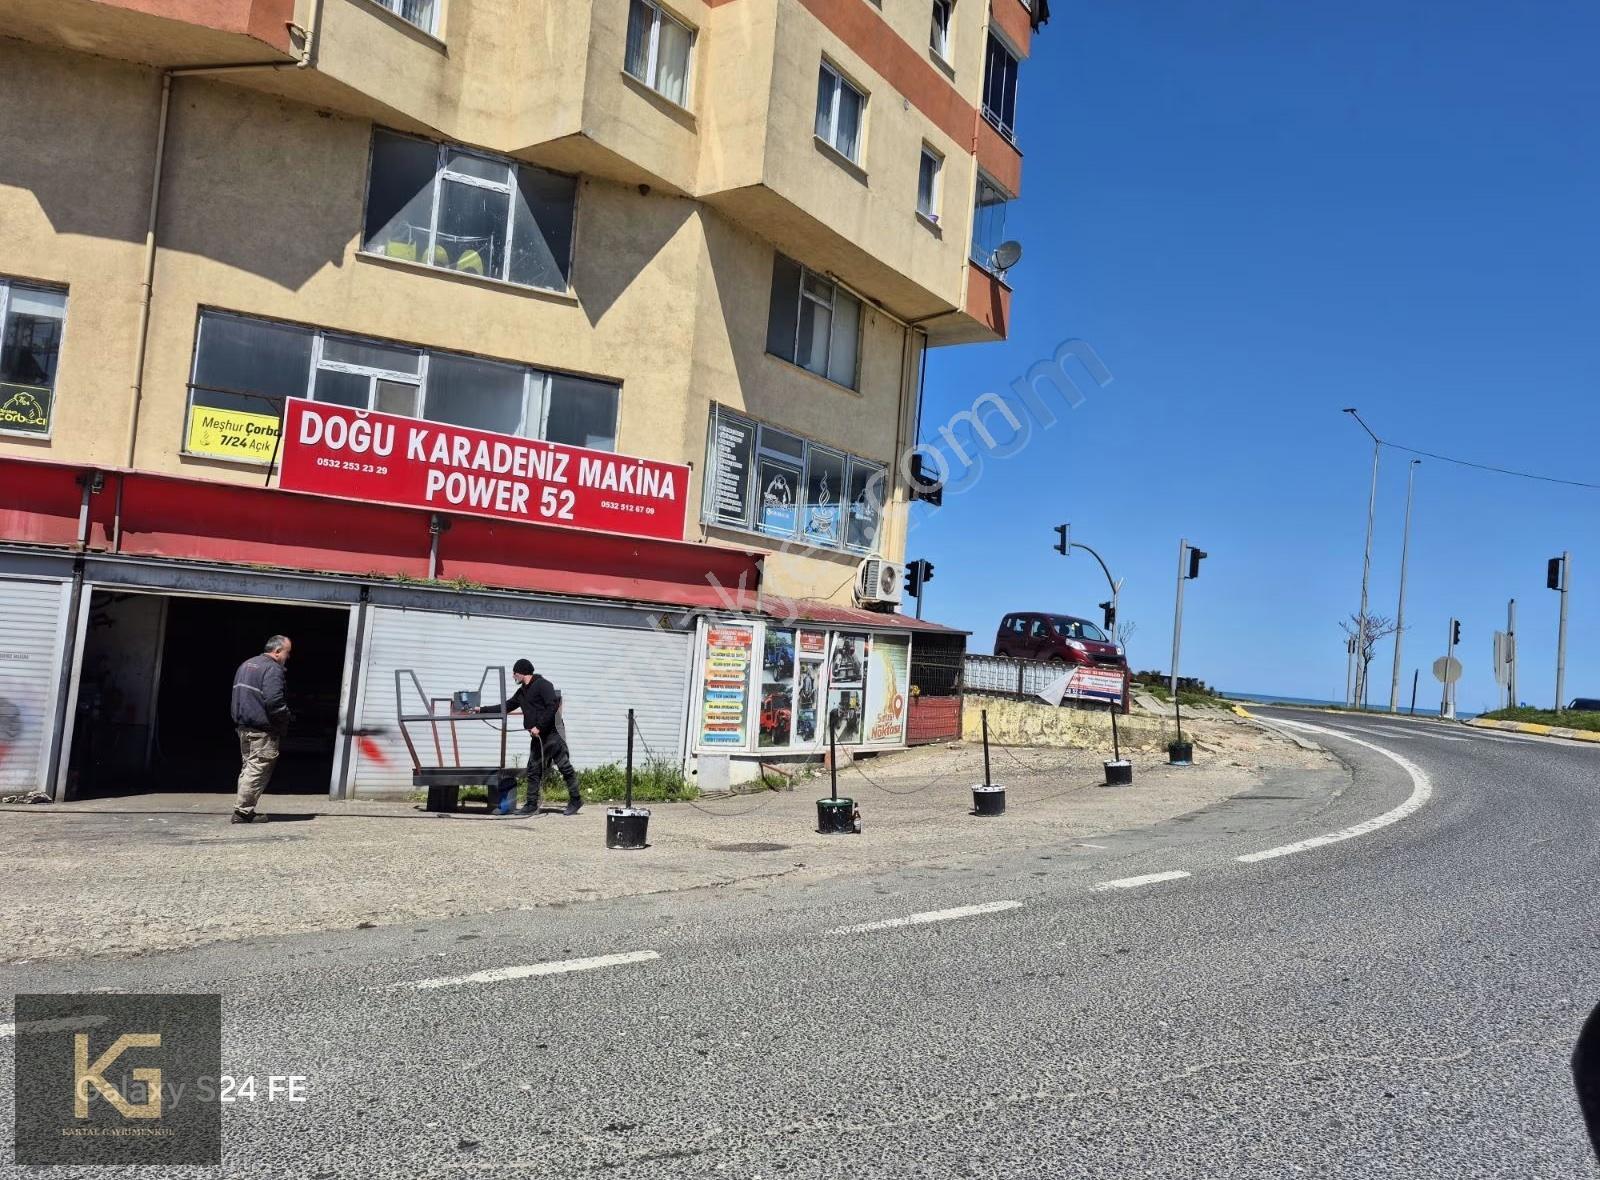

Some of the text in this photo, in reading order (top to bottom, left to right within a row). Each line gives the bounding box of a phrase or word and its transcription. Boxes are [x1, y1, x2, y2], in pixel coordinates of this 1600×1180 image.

[202, 416, 244, 432] Meşhur
[220, 434, 271, 452] 7/24 Açık
[299, 410, 395, 456] DOĞU
[407, 428, 570, 483] KARADENİZ
[578, 457, 675, 500] MAKİNA
[316, 457, 388, 475] 0532 253 23 29
[426, 469, 576, 520] POWER 52
[601, 500, 619, 510] 0532
